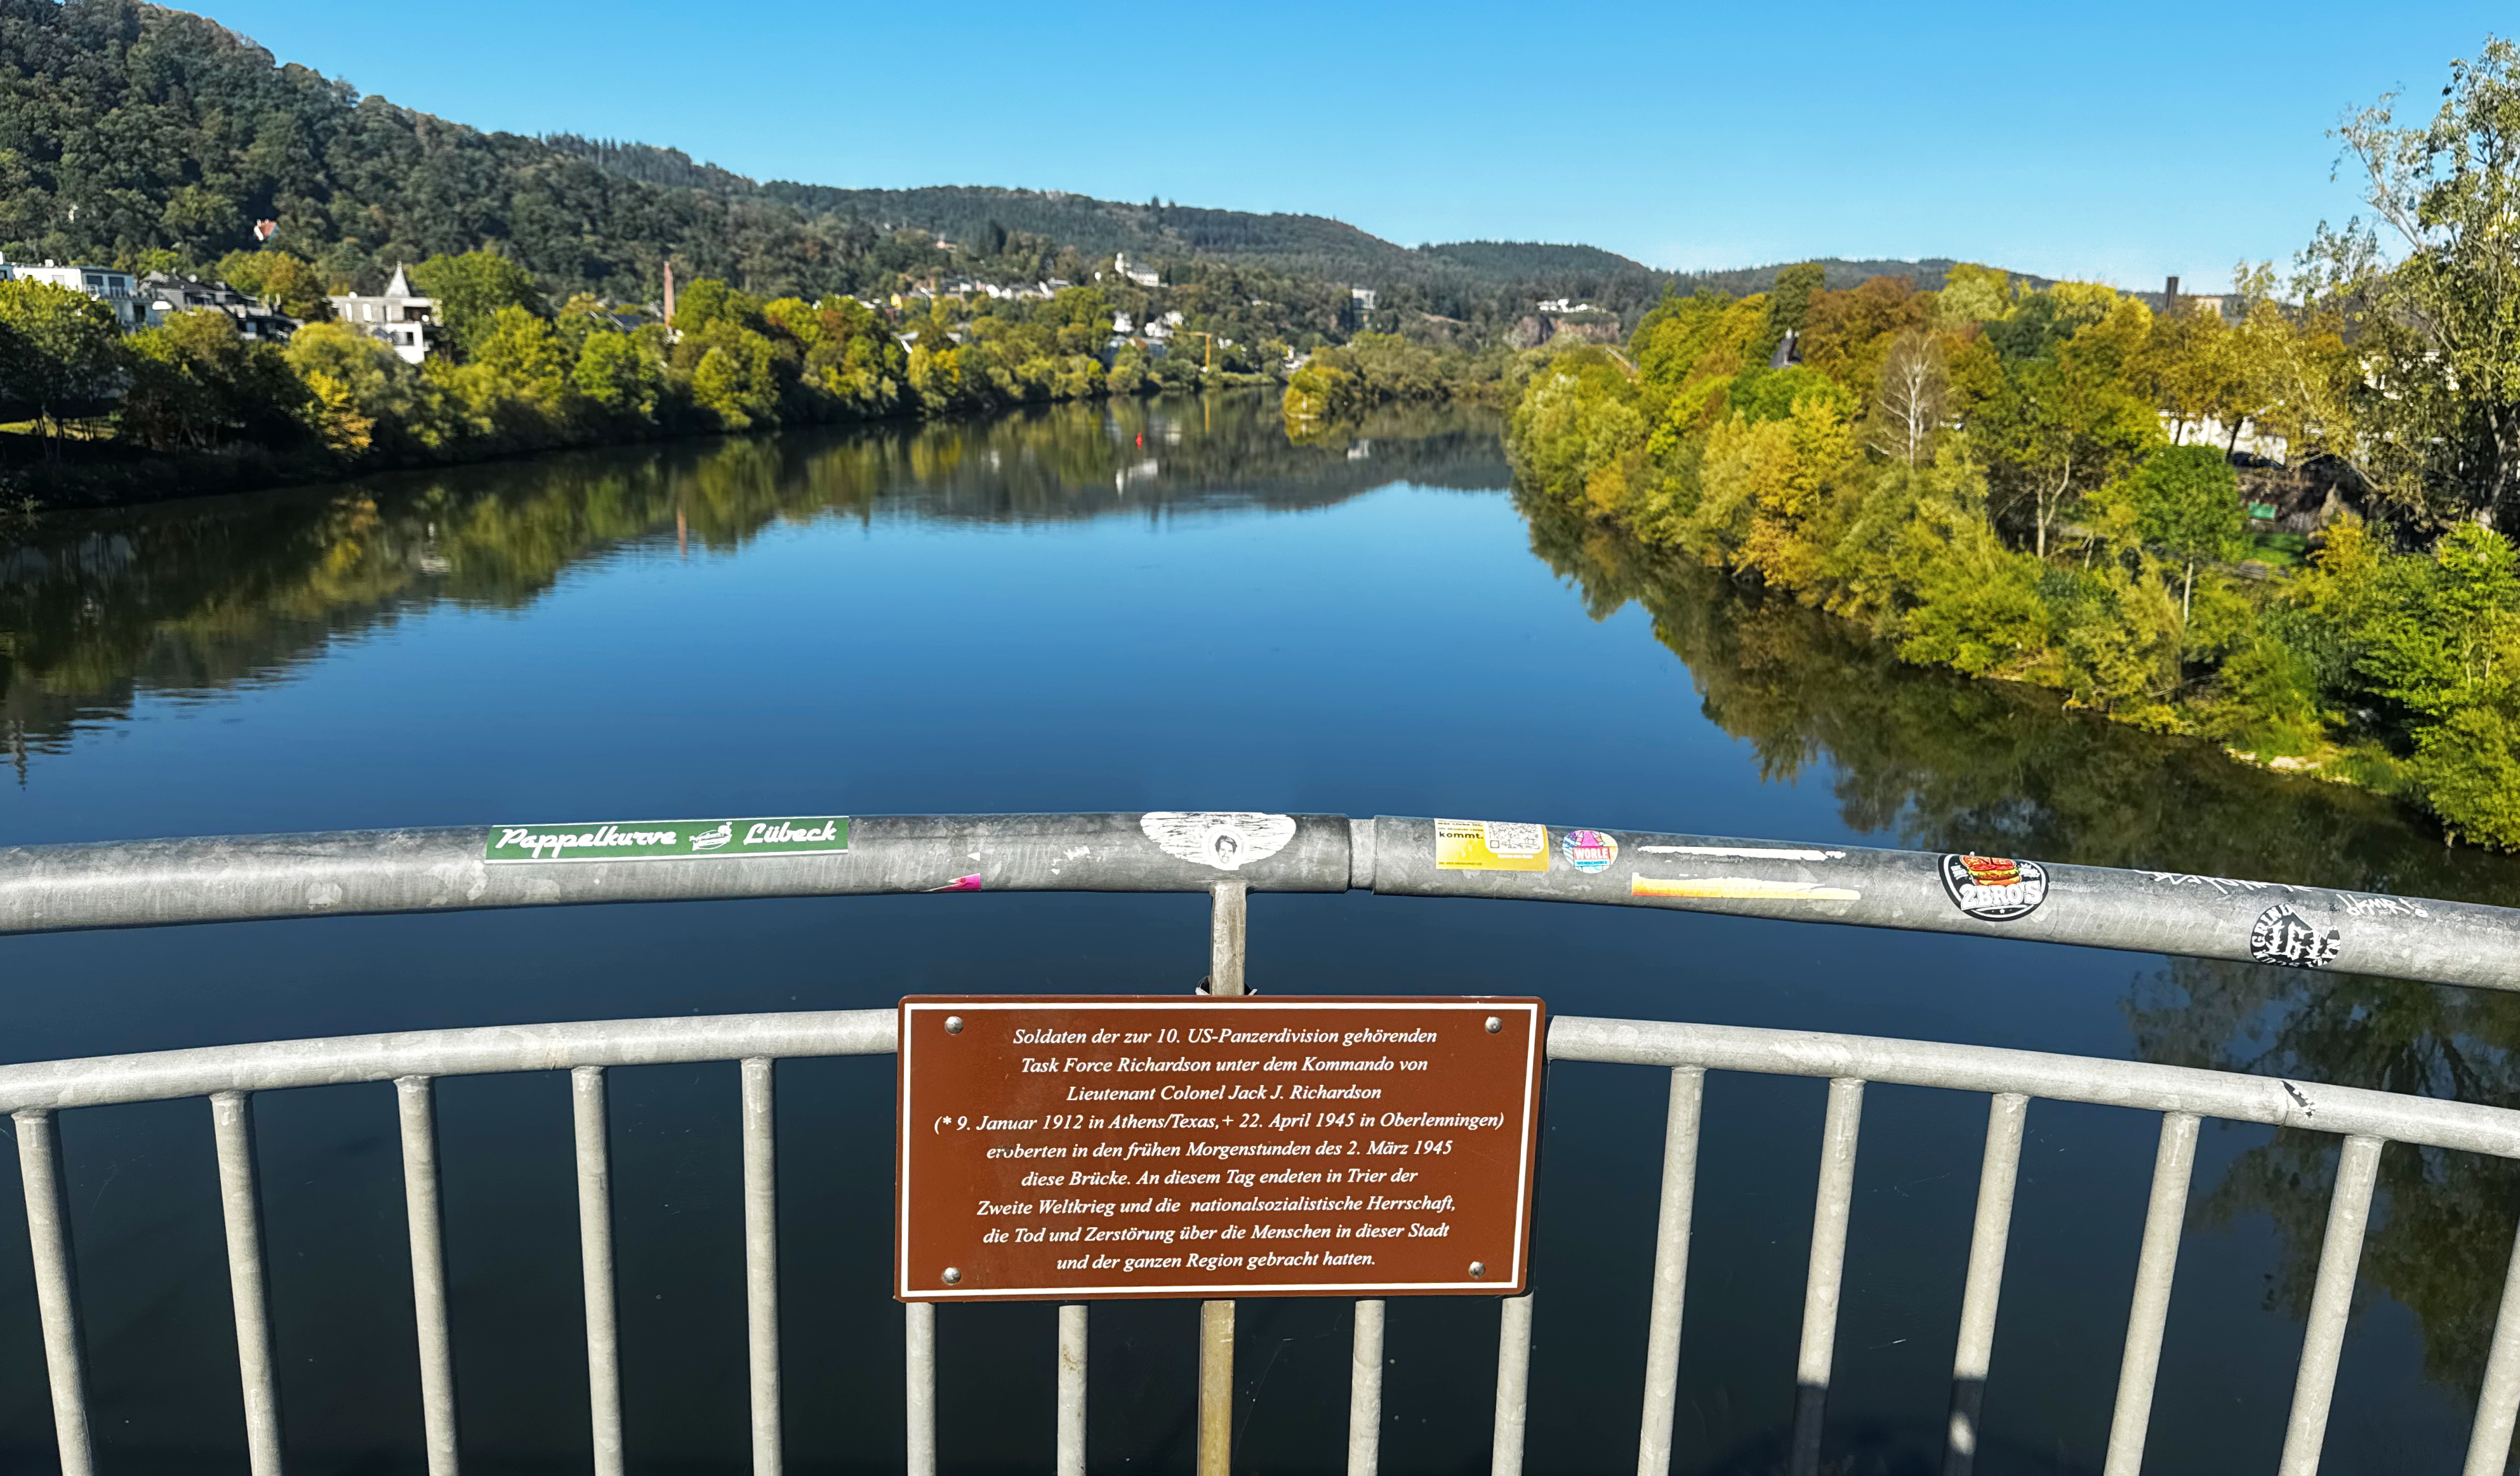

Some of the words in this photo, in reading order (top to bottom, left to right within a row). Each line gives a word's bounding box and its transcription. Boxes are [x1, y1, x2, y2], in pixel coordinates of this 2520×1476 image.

[495, 826, 677, 858] Pappelkurve
[744, 821, 837, 845] Lübeck
[1439, 831, 1484, 839] kommt.
[1959, 880, 2043, 910] 2BRO'S
[1012, 1028, 1087, 1044] Soldaten
[1091, 1028, 1121, 1044] der
[1123, 1033, 1152, 1044] zur
[1157, 1028, 1180, 1044] 10.
[1188, 1027, 1339, 1044] US-Panzerdivision
[1342, 1027, 1437, 1047] gehörenden
[1021, 1057, 1060, 1073] Task
[1062, 1058, 1113, 1072] Force
[1116, 1056, 1211, 1072] Richardson
[1216, 1059, 1260, 1072] unter
[1263, 1056, 1297, 1072] dem
[1301, 1056, 1395, 1072] Kommando
[1399, 1060, 1428, 1071] von
[1066, 1086, 1157, 1101] Lieutenant
[1160, 1084, 1226, 1100] Colonel
[1228, 1084, 1268, 1100] Jack
[1270, 1085, 1283, 1100] J.
[1289, 1084, 1382, 1100] Richardson
[956, 1115, 971, 1131] 9.
[976, 1115, 1038, 1131] Januar
[1042, 1114, 1084, 1129] 1912
[1088, 1115, 1104, 1129] in
[1238, 1113, 1263, 1128] 22.
[1268, 1112, 1312, 1131] April
[1315, 1112, 1356, 1127] 1945
[1360, 1113, 1376, 1127] in
[1380, 1112, 1504, 1131] Oberlenningen)
[986, 1143, 1067, 1159] eroberten
[1071, 1143, 1088, 1157] in
[1092, 1142, 1124, 1157] den
[1123, 1141, 1181, 1161] frühen
[1185, 1140, 1311, 1160] Morgenstunden
[1315, 1140, 1343, 1155] des
[1346, 1140, 1360, 1155] 2.
[1365, 1140, 1409, 1155] März
[1413, 1140, 1453, 1155] 1945
[1021, 1171, 1065, 1187] diese
[1068, 1170, 1131, 1186] Brücke.
[1135, 1170, 1160, 1185] An
[1164, 1169, 1221, 1185] diesem
[1226, 1169, 1256, 1188] Tag
[1259, 1168, 1322, 1184] endeten
[1326, 1169, 1343, 1183] in
[1347, 1168, 1388, 1183] Trier
[1390, 1167, 1419, 1183] der
[976, 1200, 1033, 1216] Zweite
[1039, 1199, 1117, 1217] Weltkrieg
[1120, 1197, 1153, 1213] und
[1155, 1197, 1181, 1213] die
[1190, 1195, 1363, 1212] nationalsozialistische
[1365, 1195, 1456, 1214] Herrschaft,
[983, 1228, 1009, 1244] die
[1014, 1227, 1047, 1243] Tod
[1049, 1227, 1082, 1242] und
[1084, 1227, 1176, 1244] Zerstörung
[1179, 1225, 1218, 1240] über
[1221, 1224, 1247, 1239] die
[1250, 1223, 1331, 1239] Menschen
[1336, 1224, 1351, 1238] in
[1355, 1223, 1405, 1238] dieser
[1407, 1222, 1450, 1237] Stadt
[1057, 1254, 1090, 1270] und
[1092, 1254, 1121, 1269] der
[1123, 1258, 1182, 1272] ganzen
[1185, 1253, 1243, 1271] Region
[1246, 1251, 1320, 1270] gebracht
[1322, 1251, 1376, 1266] hatten.
